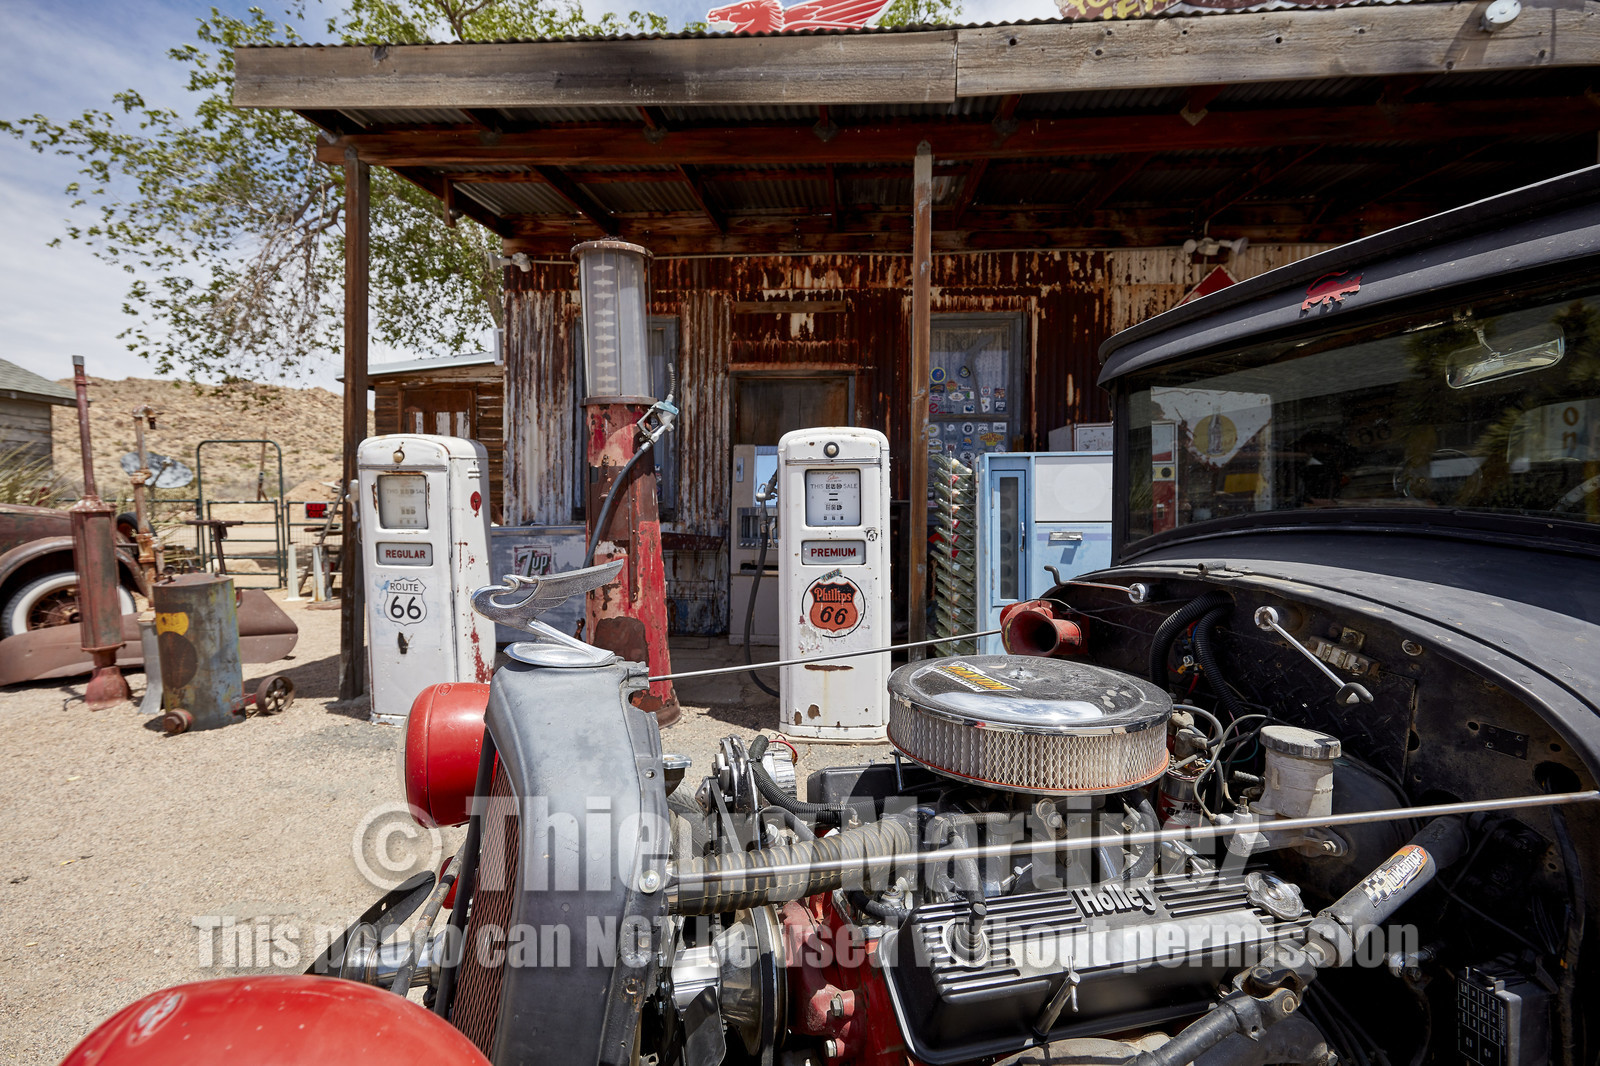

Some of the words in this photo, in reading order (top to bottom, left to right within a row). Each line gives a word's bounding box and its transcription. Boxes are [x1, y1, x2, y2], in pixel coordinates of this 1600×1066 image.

[385, 549, 426, 559] REGULAR
[810, 548, 856, 557] PREMIUM
[390, 582, 419, 592] ROUTE
[814, 587, 852, 605] Phillips
[390, 595, 422, 620] 66
[820, 606, 848, 625] 66
[1070, 884, 1157, 917] Holley
